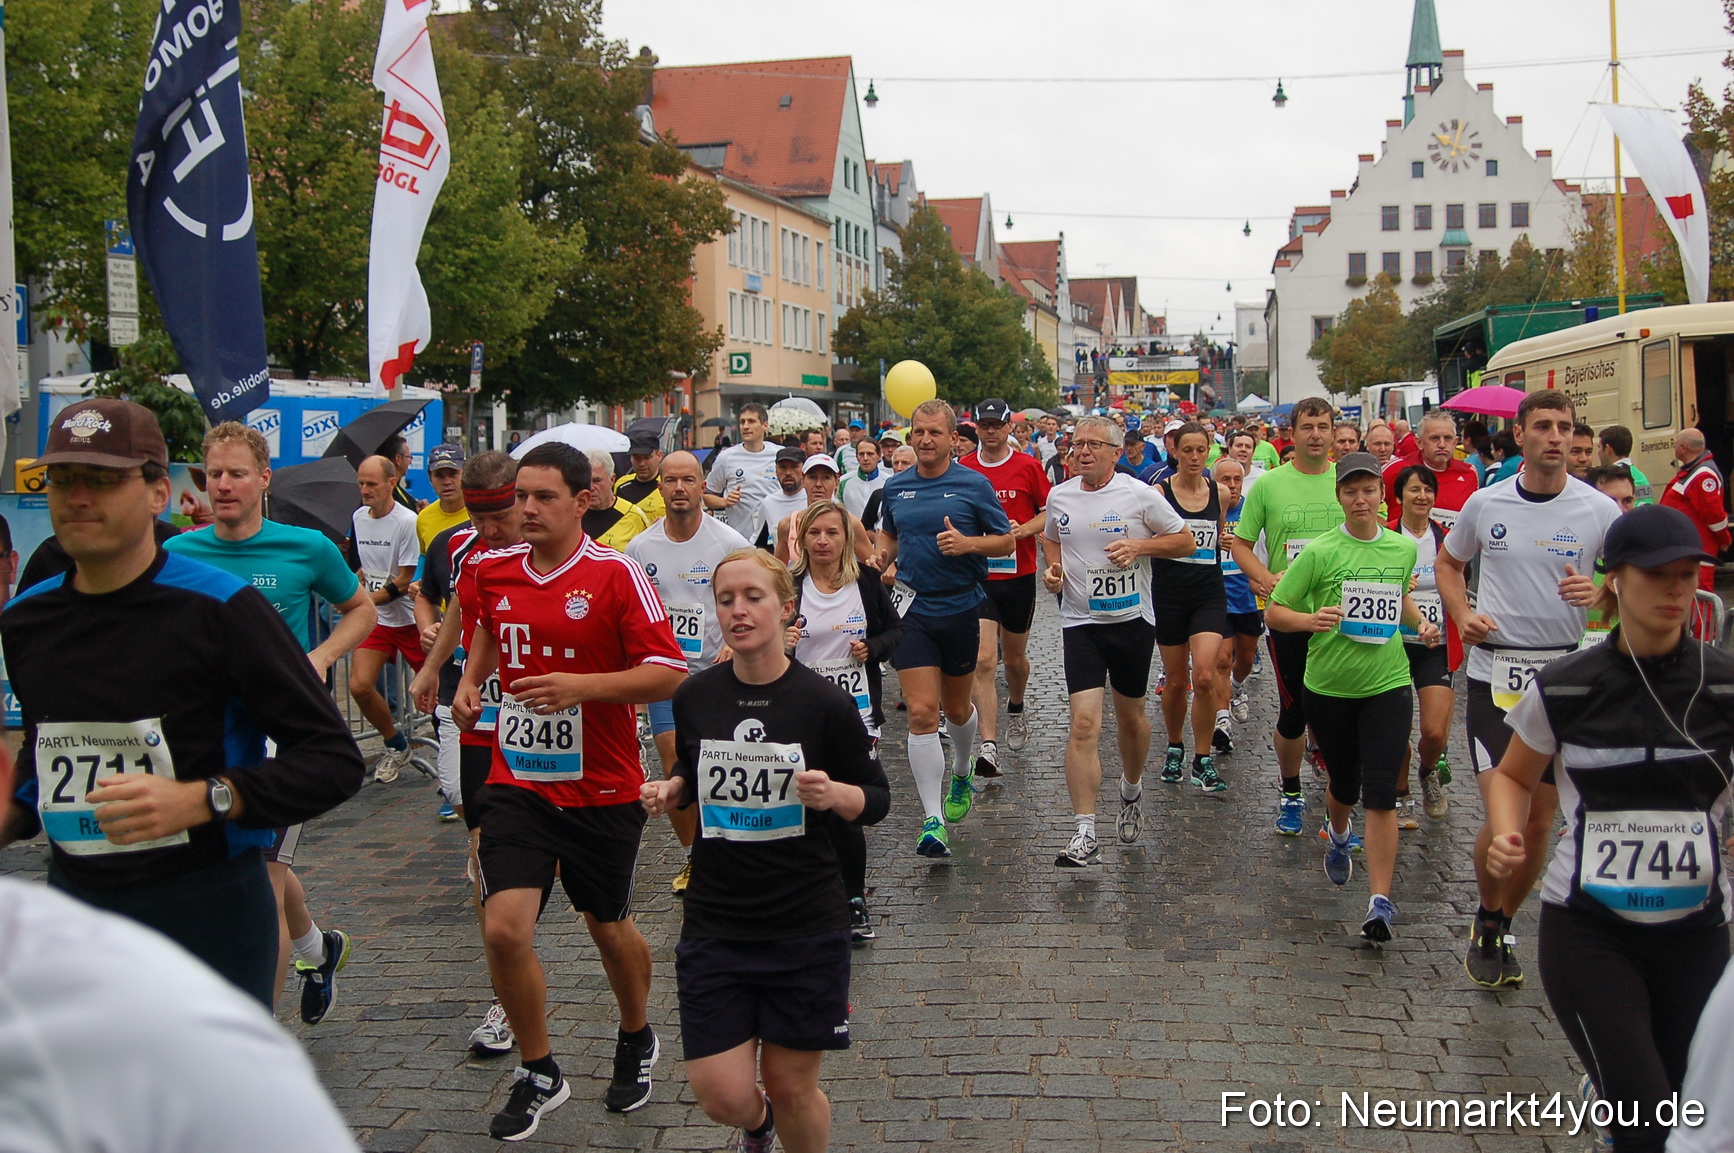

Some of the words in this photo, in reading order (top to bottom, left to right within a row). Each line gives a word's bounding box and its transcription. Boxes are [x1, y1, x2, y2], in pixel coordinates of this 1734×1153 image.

[732, 354, 748, 372] D
[1137, 374, 1169, 382] START
[1565, 359, 1615, 387] Bayerisches
[1641, 439, 1670, 454] Bayerisches
[252, 577, 277, 586] 2012
[1092, 572, 1136, 597] 2611
[1367, 588, 1394, 596] Neumarkt
[1099, 598, 1133, 610] Wolfgang
[1347, 596, 1397, 621] 2385
[1361, 625, 1384, 635] Anita
[1495, 655, 1520, 664] PARTL
[825, 663, 856, 673] Neumarkt
[503, 701, 524, 713] PARTL
[505, 716, 573, 750] 2348
[38, 735, 80, 748] PARTL
[82, 735, 141, 747] Neumarkt
[515, 756, 557, 770] Markus
[702, 750, 733, 760] PARTL
[735, 752, 785, 763] Neumarkt
[708, 765, 794, 803] 2347
[730, 812, 772, 827] Nicole
[1587, 823, 1625, 833] PARTL
[1627, 823, 1686, 833] Neumarkt
[1595, 839, 1701, 880] 2744
[1627, 893, 1665, 908] Nina
